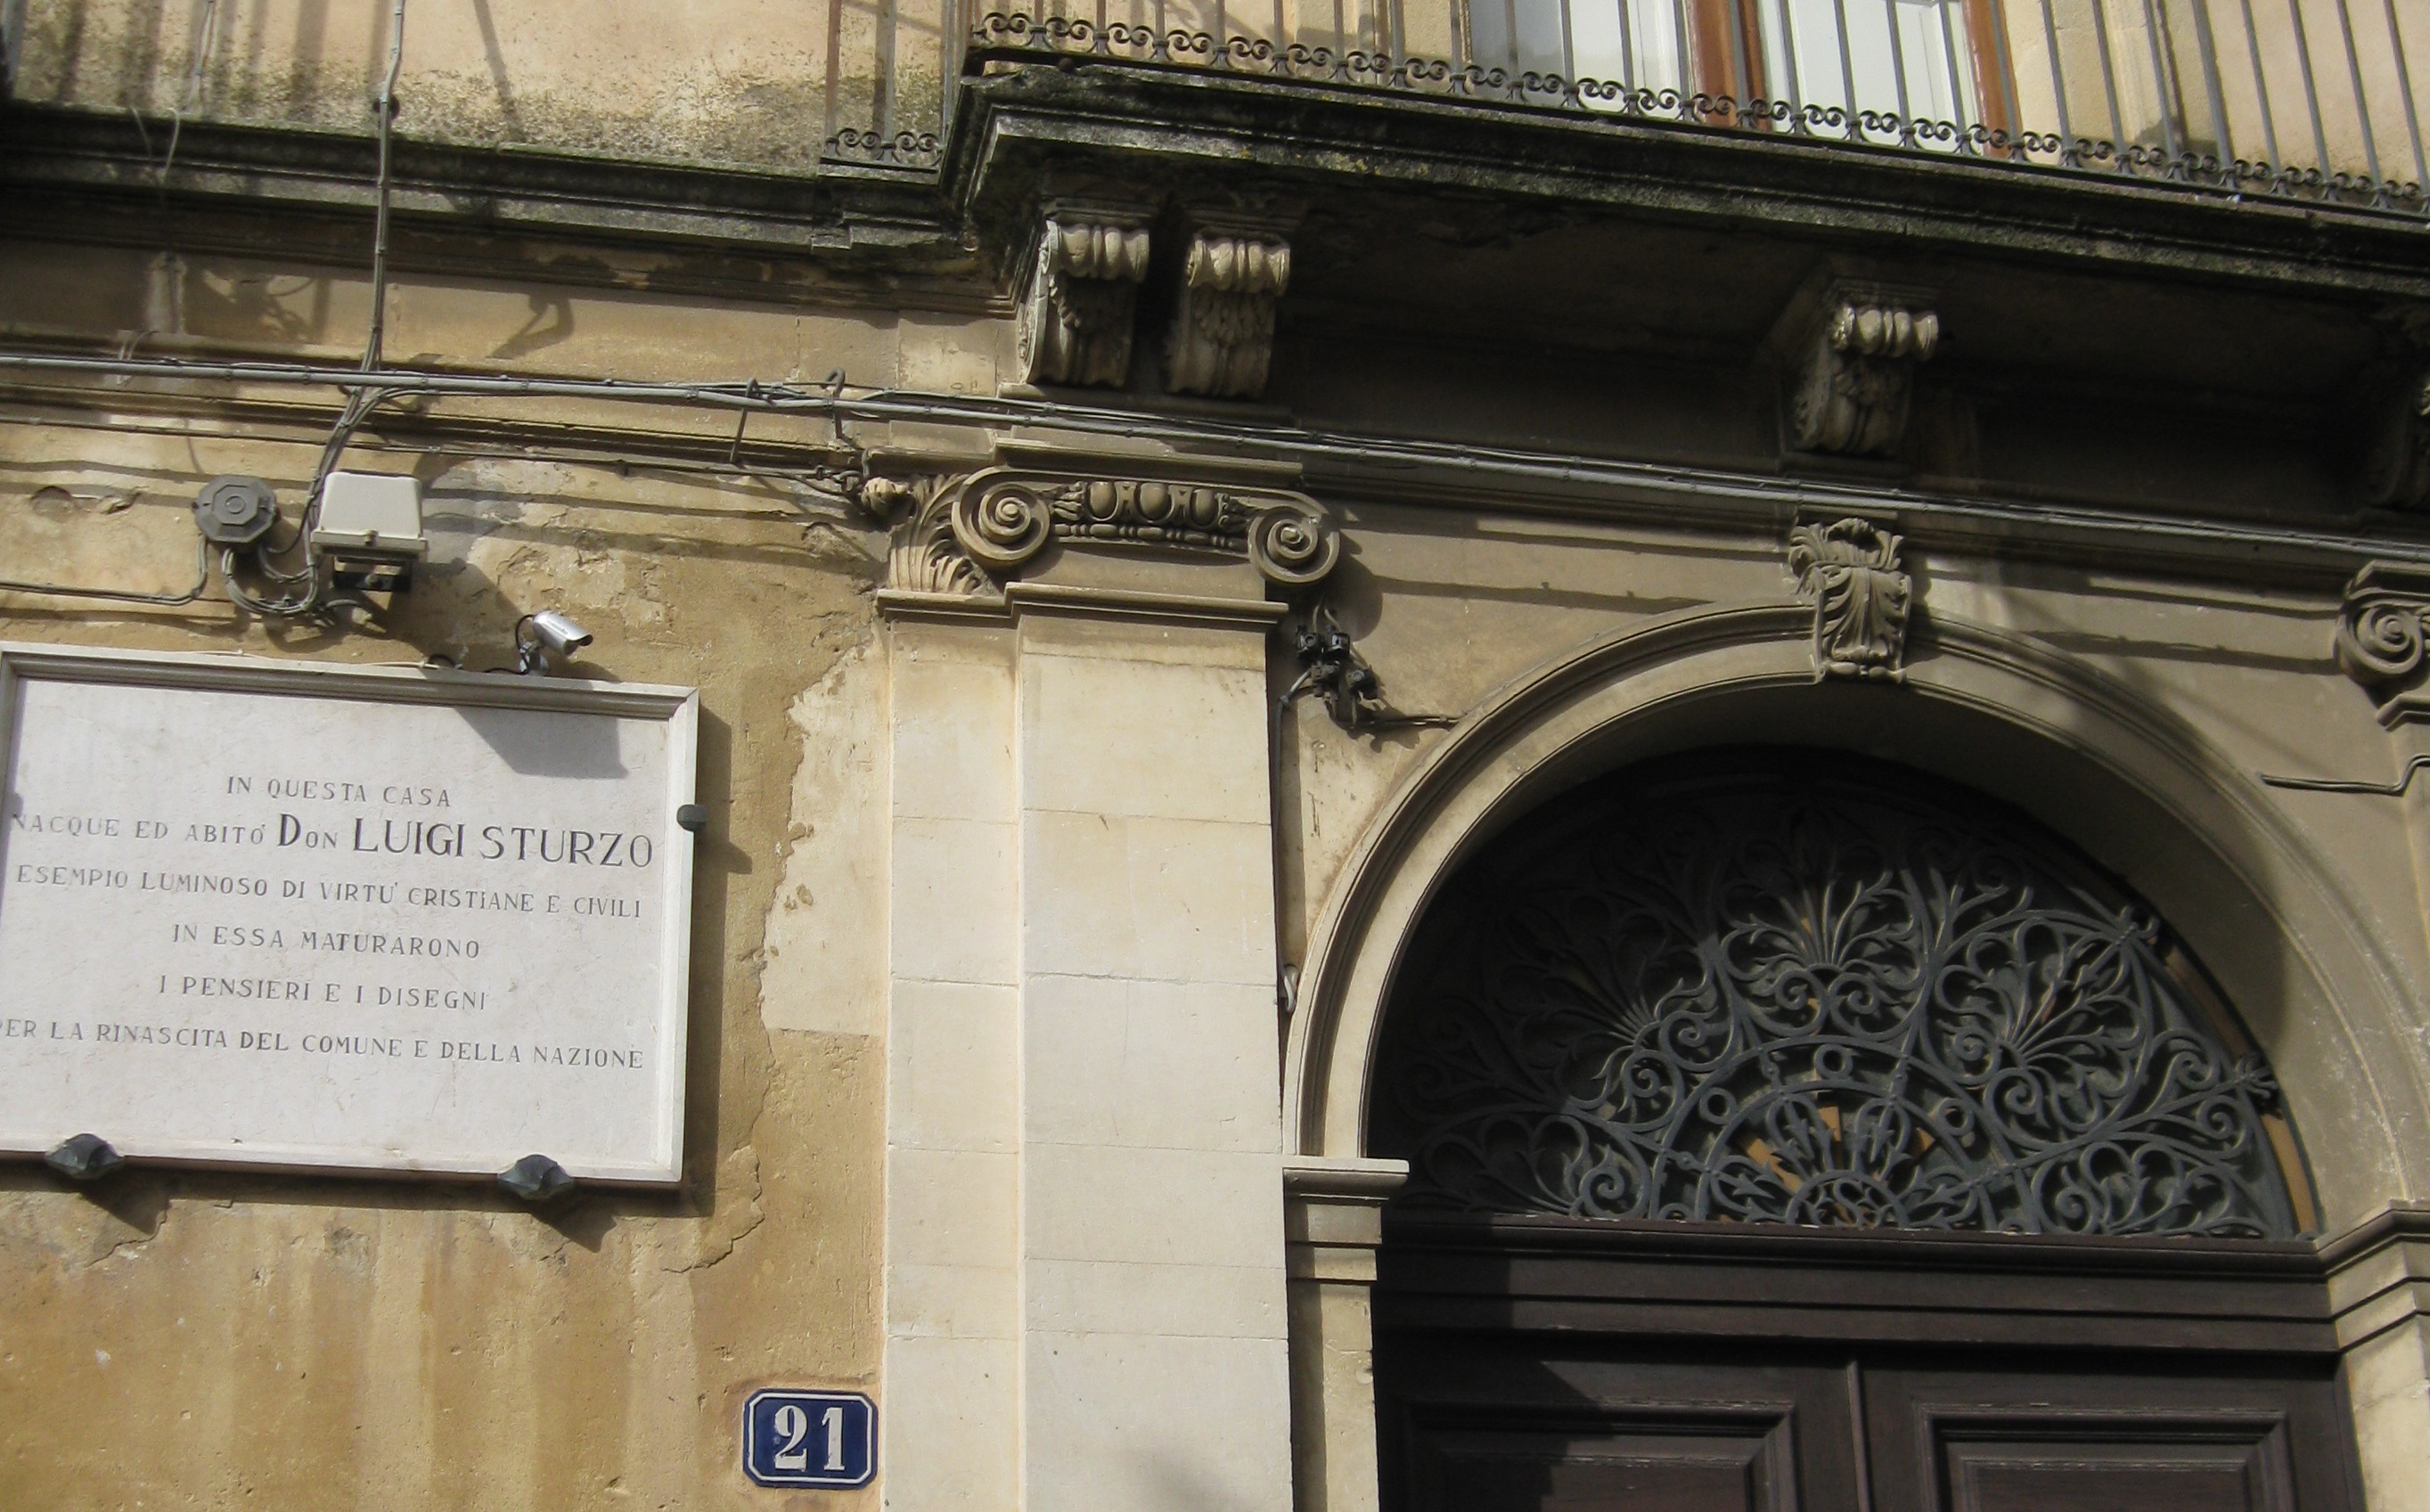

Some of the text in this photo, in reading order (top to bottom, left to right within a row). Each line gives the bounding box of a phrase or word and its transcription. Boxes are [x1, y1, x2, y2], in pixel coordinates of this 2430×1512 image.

[226, 776, 451, 807] IN QUESTA CASA
[135, 819, 168, 840] ED
[353, 817, 466, 858] LUIGI
[481, 825, 654, 869] STURZO
[17, 863, 128, 888] ESEMPIO
[141, 870, 268, 896] LUMINOSO
[282, 879, 306, 899] DI
[408, 887, 535, 912] CRISTIANE
[547, 894, 560, 913] E
[574, 896, 642, 919] CIVILI
[173, 924, 480, 960] IN ESSA MATURARONO
[159, 975, 487, 1011] I PENSIERI E I DISEGNI
[0, 1018, 644, 1070] ER LA RINASCITA DEL COMUNE E DELLA NAZIONE
[774, 1405, 846, 1471] 21
